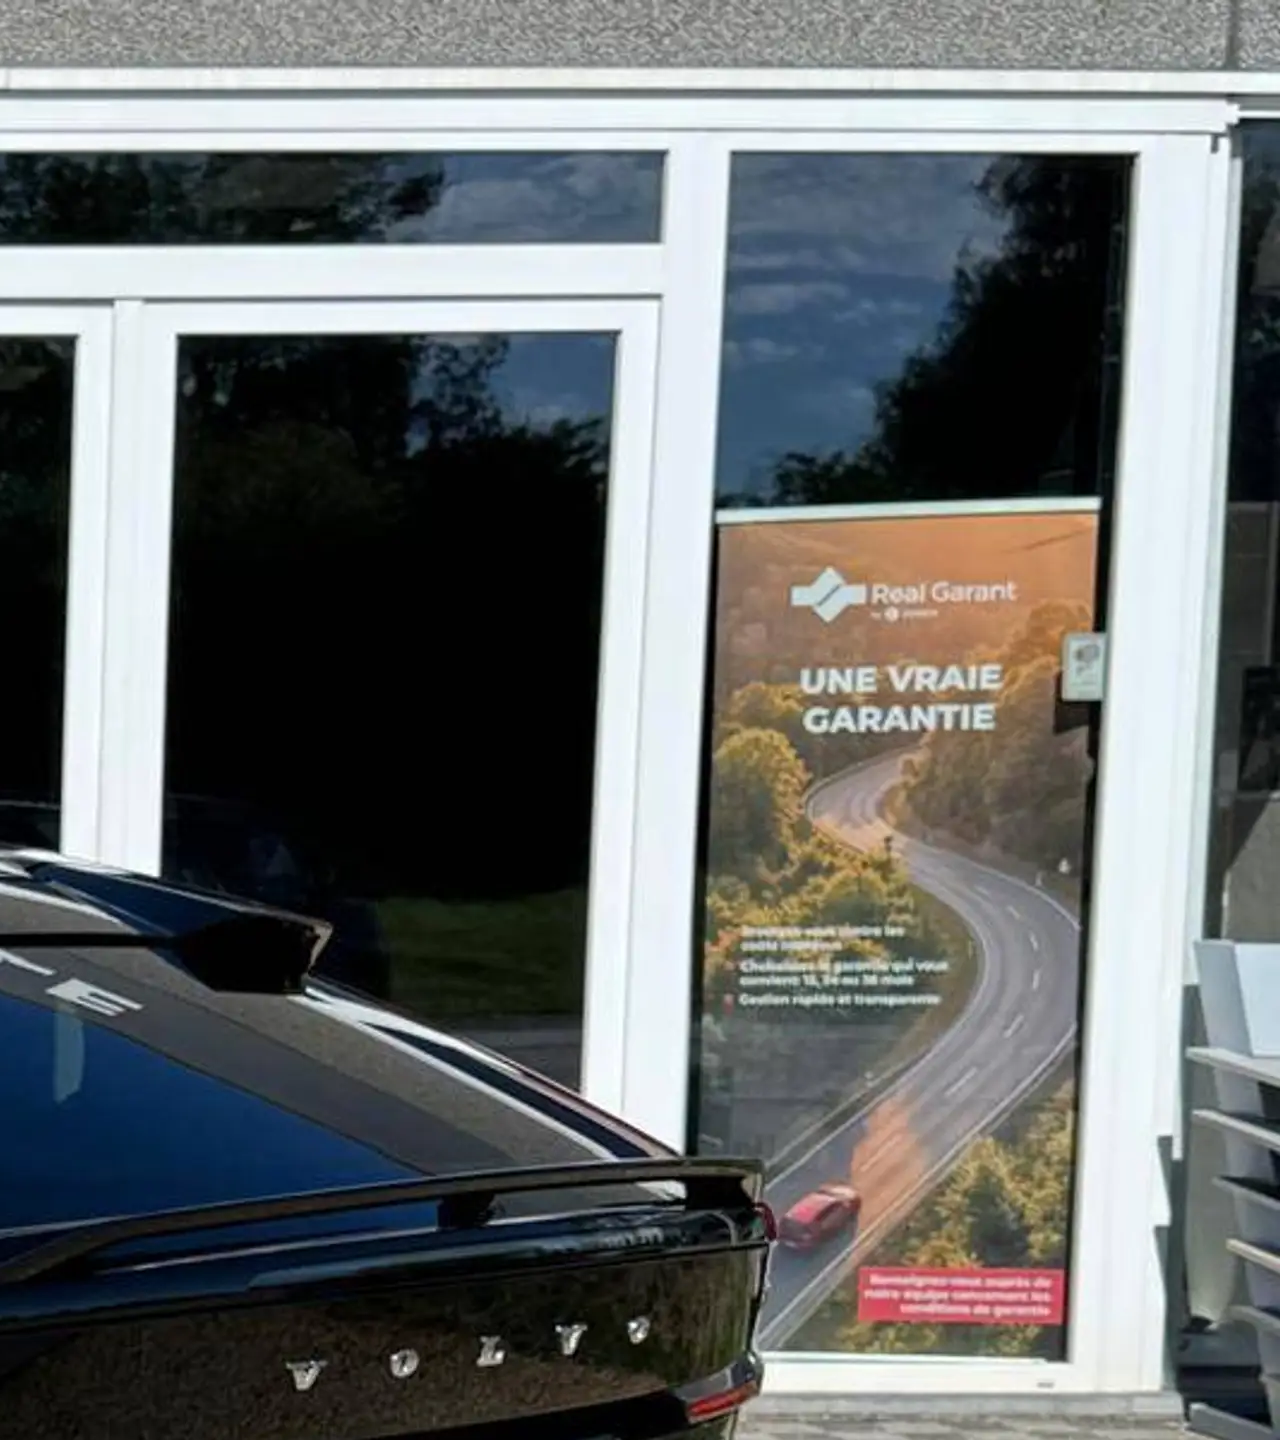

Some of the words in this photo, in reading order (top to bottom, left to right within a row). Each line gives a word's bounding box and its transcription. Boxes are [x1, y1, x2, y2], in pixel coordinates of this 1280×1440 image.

[871, 583, 926, 605] Real
[931, 580, 1018, 602] Garant
[799, 666, 878, 695] UNE
[887, 664, 1004, 692] VRAIE
[802, 703, 997, 734] GARANTIE
[285, 1316, 650, 1391] VOLVO
